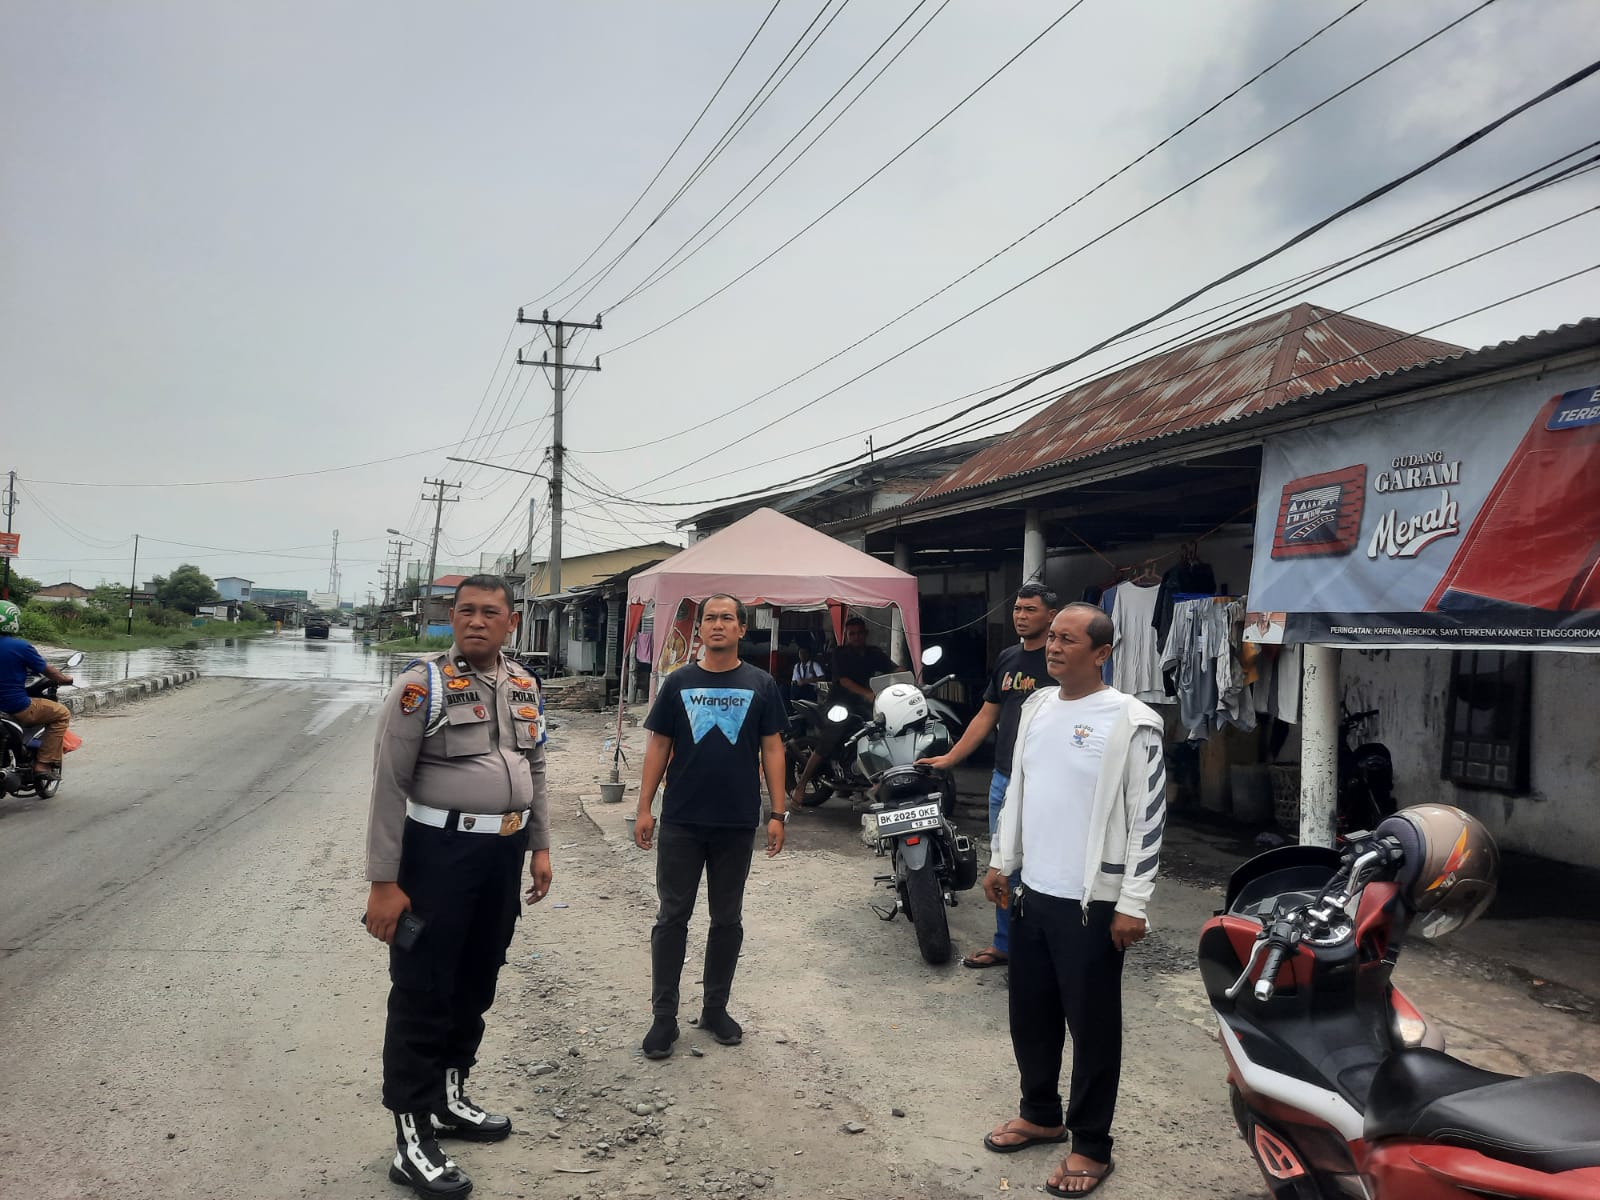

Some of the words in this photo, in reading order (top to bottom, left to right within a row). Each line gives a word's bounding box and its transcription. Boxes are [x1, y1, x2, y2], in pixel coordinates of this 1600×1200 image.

[1558, 405, 1600, 423] TERB
[1391, 450, 1442, 468] GUDANG
[1374, 461, 1460, 493] GARAM
[1367, 489, 1458, 558] Merah
[1330, 626, 1373, 635] PERINGATAN:
[1373, 627, 1402, 636] KARENA
[1440, 628, 1459, 636] SAYA
[1460, 628, 1497, 637] TERKENA
[1498, 628, 1533, 637] KANKER
[446, 691, 480, 705] BINTARA
[512, 690, 536, 703] POLRI
[690, 694, 745, 712] Wrangler
[880, 815, 892, 825] BK
[894, 810, 917, 822] 2025
[918, 807, 936, 817] OKE
